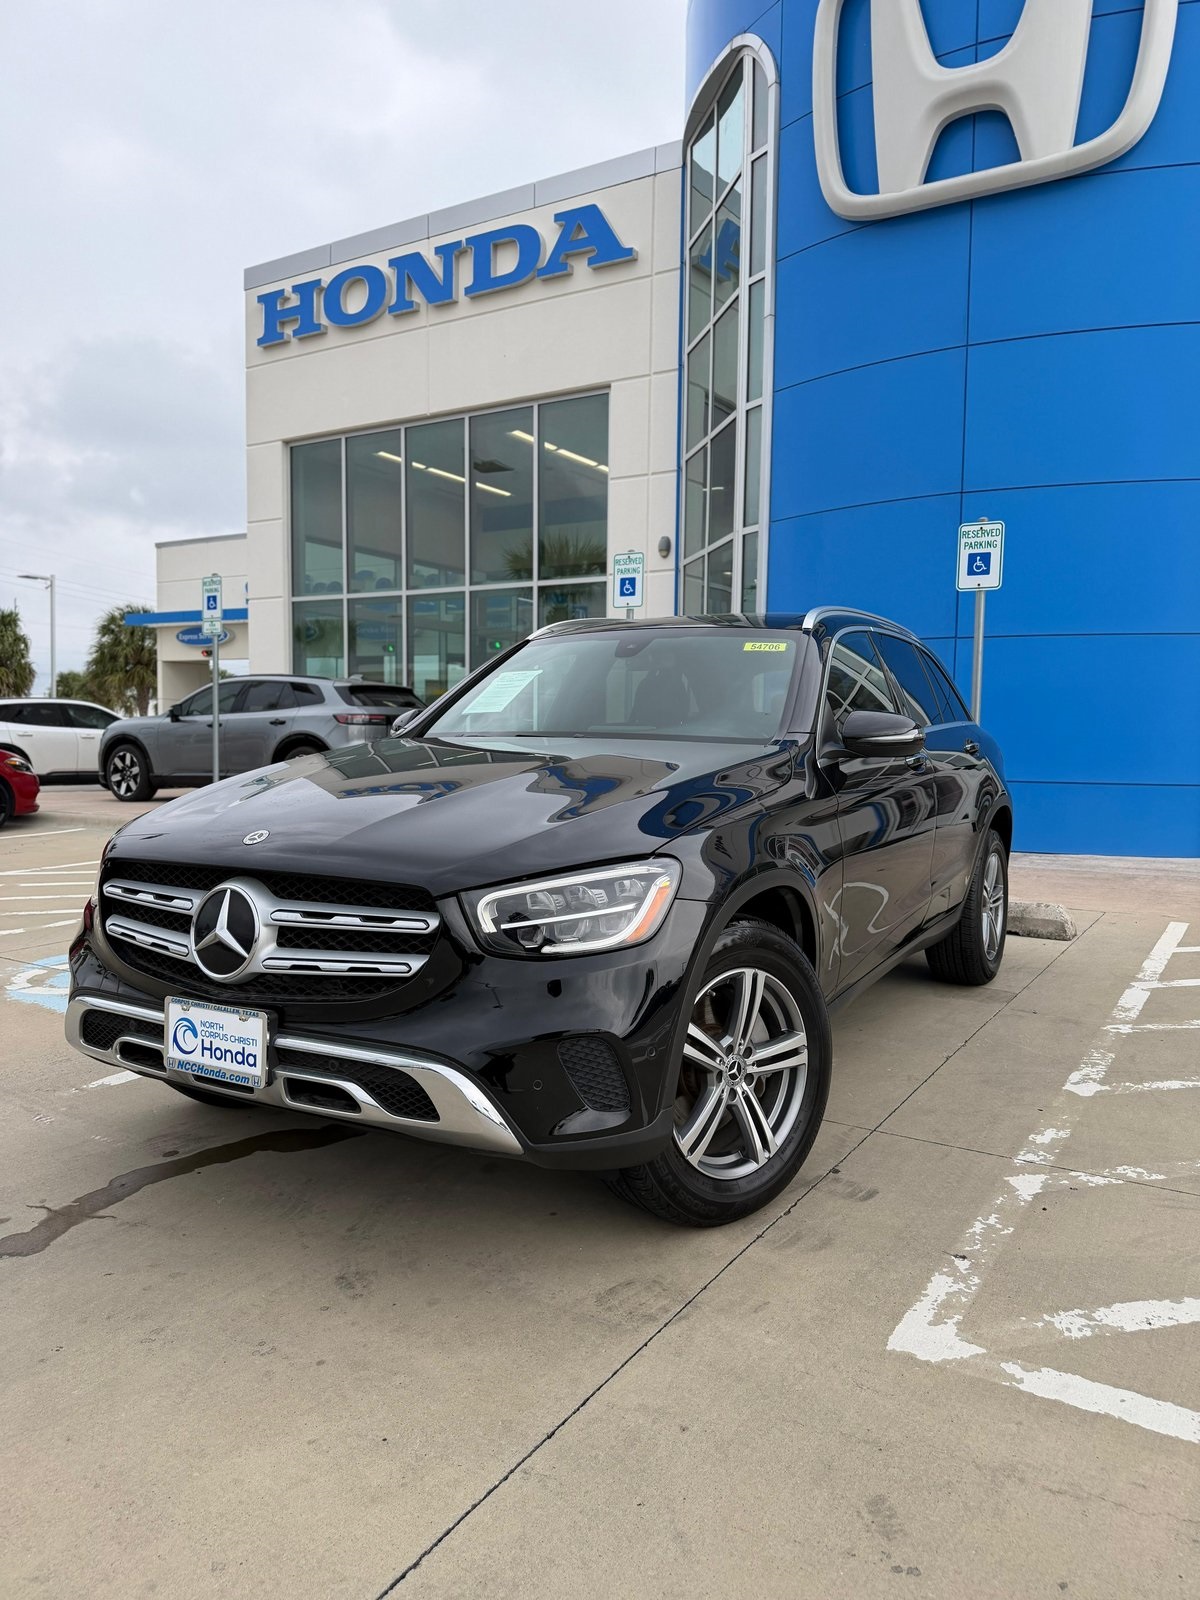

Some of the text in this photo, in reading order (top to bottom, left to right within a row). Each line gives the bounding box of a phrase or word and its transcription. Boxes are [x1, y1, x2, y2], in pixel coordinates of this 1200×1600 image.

[257, 204, 637, 348] HONDA
[962, 528, 1001, 539] RESERVED
[964, 540, 998, 550] PARKING
[615, 557, 642, 566] RESERVED
[617, 567, 640, 575] PARKING
[171, 998, 190, 1006] CORPUS
[191, 1002, 210, 1010] CHRISTI
[242, 1010, 259, 1018] TEXAS
[200, 1020, 224, 1031] NORTH
[200, 1030, 257, 1047] CORPUS CHRISTI
[201, 1039, 257, 1068] Honda
[177, 1060, 250, 1084] NCCHonda.com
